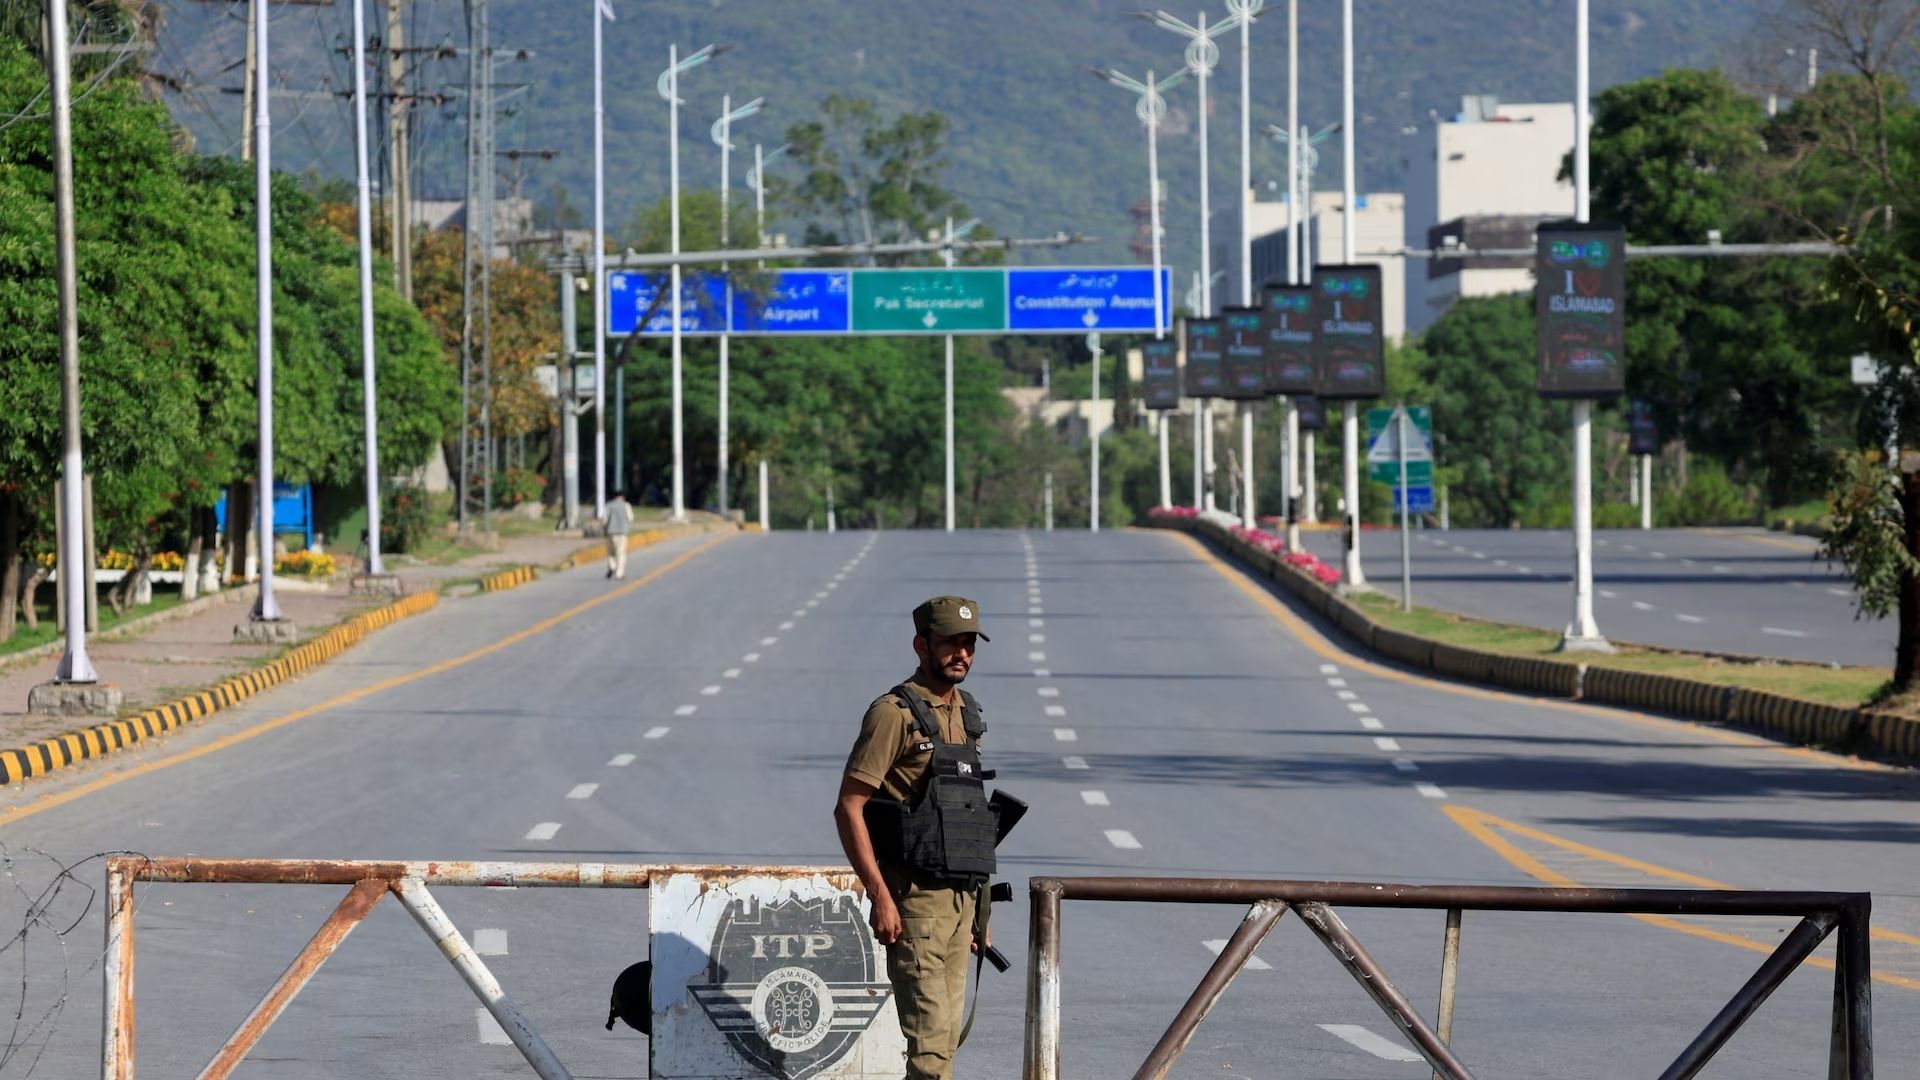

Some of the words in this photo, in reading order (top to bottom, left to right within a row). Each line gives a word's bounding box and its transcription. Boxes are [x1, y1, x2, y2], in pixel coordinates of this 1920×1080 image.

[1564, 270, 1575, 294] I
[874, 296, 900, 309] Pak
[904, 296, 984, 309] Secretariat
[1015, 295, 1105, 309] Constitution
[1110, 295, 1155, 309] Avenu
[1549, 295, 1616, 314] ISLAMABAD
[763, 306, 819, 324] Airport
[751, 933, 835, 959] ITP
[759, 1019, 795, 1049] TRFFIC
